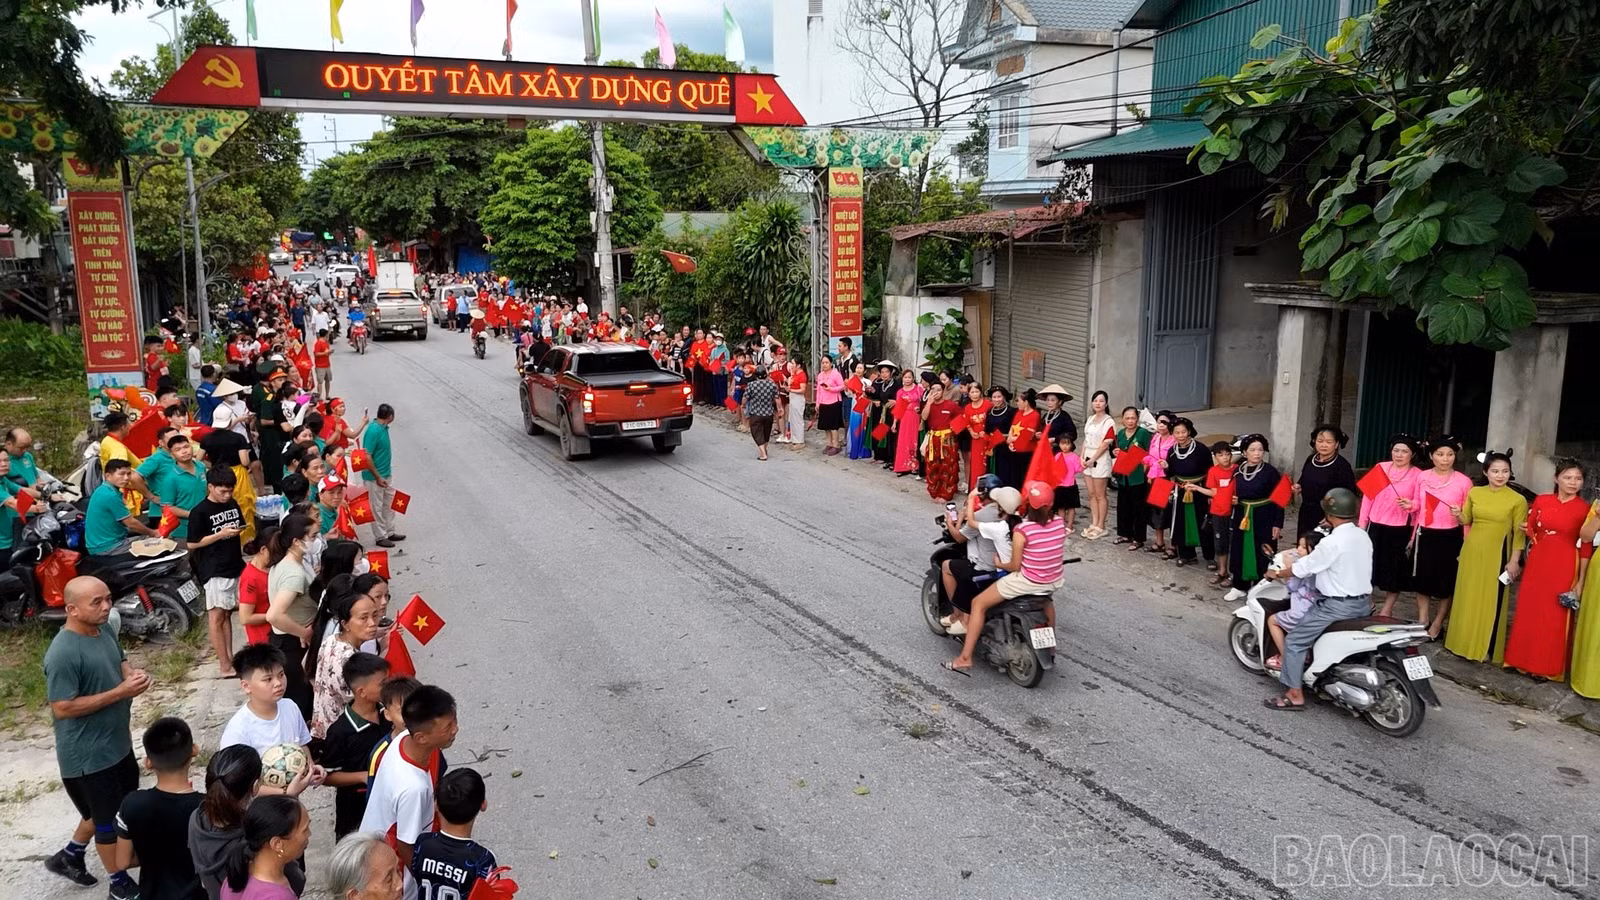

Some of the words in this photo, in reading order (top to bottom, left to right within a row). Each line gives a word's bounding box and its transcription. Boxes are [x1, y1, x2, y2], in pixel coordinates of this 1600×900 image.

[445, 64, 514, 96] TÂM
[520, 68, 584, 98] XÂY
[590, 75, 672, 105] DỰNG
[678, 77, 730, 110] QUÊ
[79, 210, 93, 220] XÂY
[78, 223, 97, 232] PHÁT
[99, 222, 120, 232] TRIỂN
[82, 234, 96, 245] ĐẤT
[98, 234, 119, 245] NƯỚC
[92, 248, 112, 257] TRÊN
[84, 261, 101, 269] TINH
[102, 259, 122, 270] THẦN
[94, 285, 104, 295] TỰ
[94, 298, 103, 308] TỰ
[90, 309, 99, 320] TỰ
[97, 321, 106, 331] TỰ
[108, 320, 122, 330] HÀO
[92, 332, 108, 342] DÂN
[422, 858, 468, 884] MESSI
